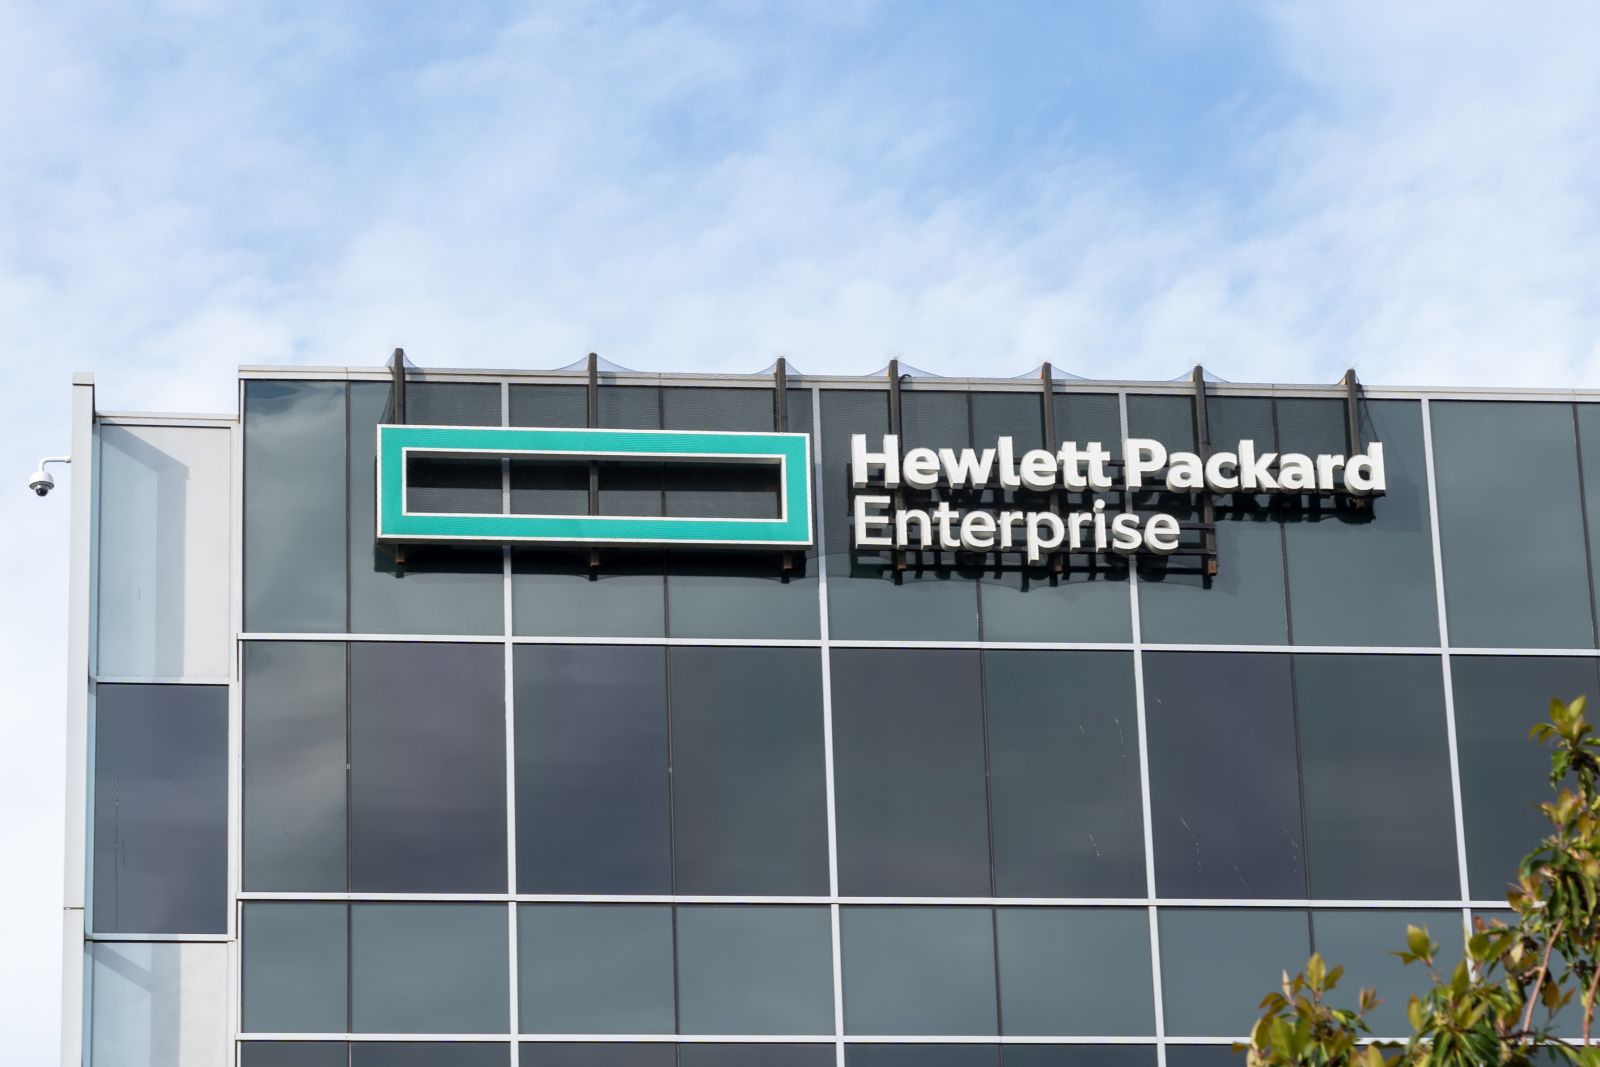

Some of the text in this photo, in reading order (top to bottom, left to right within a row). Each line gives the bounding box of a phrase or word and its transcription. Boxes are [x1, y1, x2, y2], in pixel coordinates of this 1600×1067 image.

[851, 433, 1387, 494] Hewlett Packard
[853, 495, 1181, 564] Enterprise
